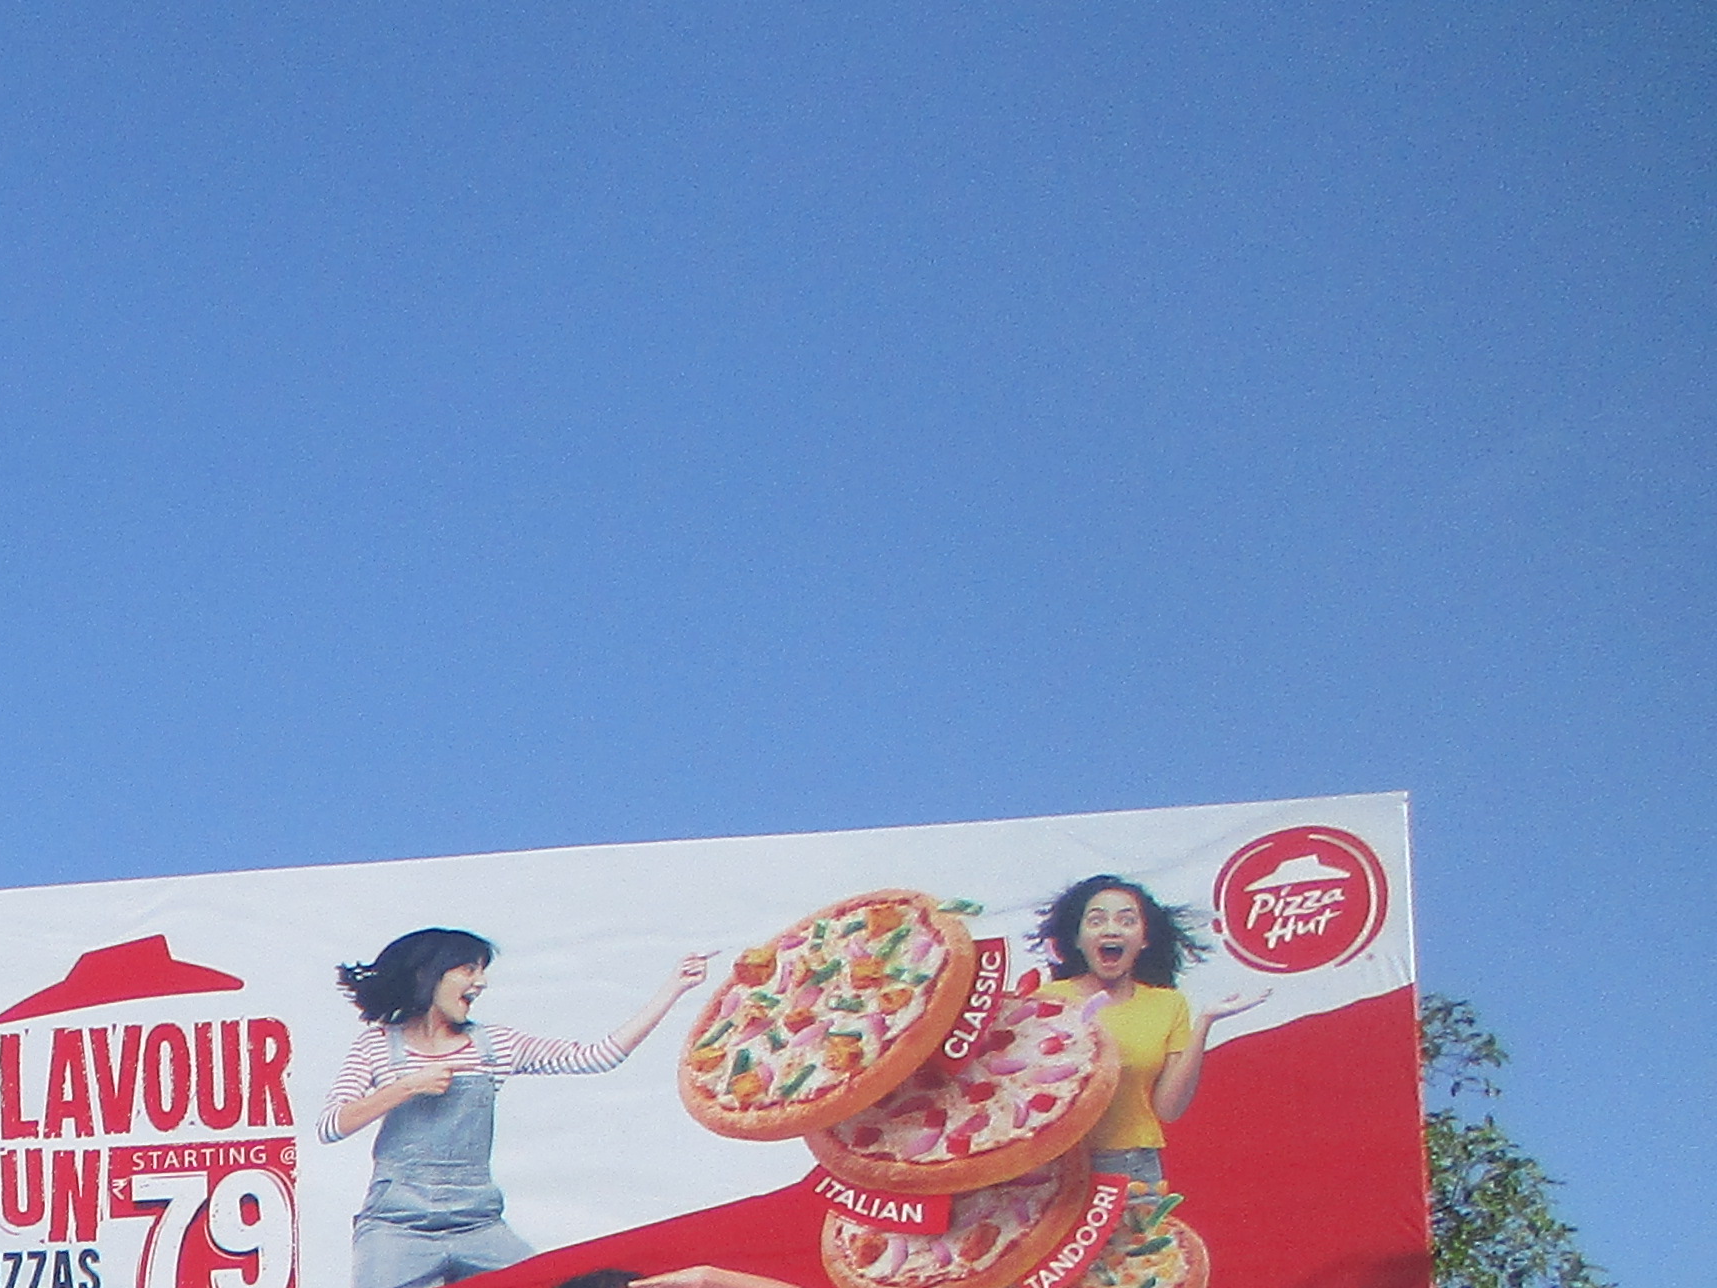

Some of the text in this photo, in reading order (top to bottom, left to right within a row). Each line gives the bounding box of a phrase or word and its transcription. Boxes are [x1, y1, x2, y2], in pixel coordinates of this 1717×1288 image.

[1246, 885, 1346, 928] Pizza
[1264, 908, 1334, 950] Hut
[943, 950, 1003, 1061] CLASSIC
[131, 1146, 268, 1172] STARTING
[814, 1176, 924, 1225] ITALIAN
